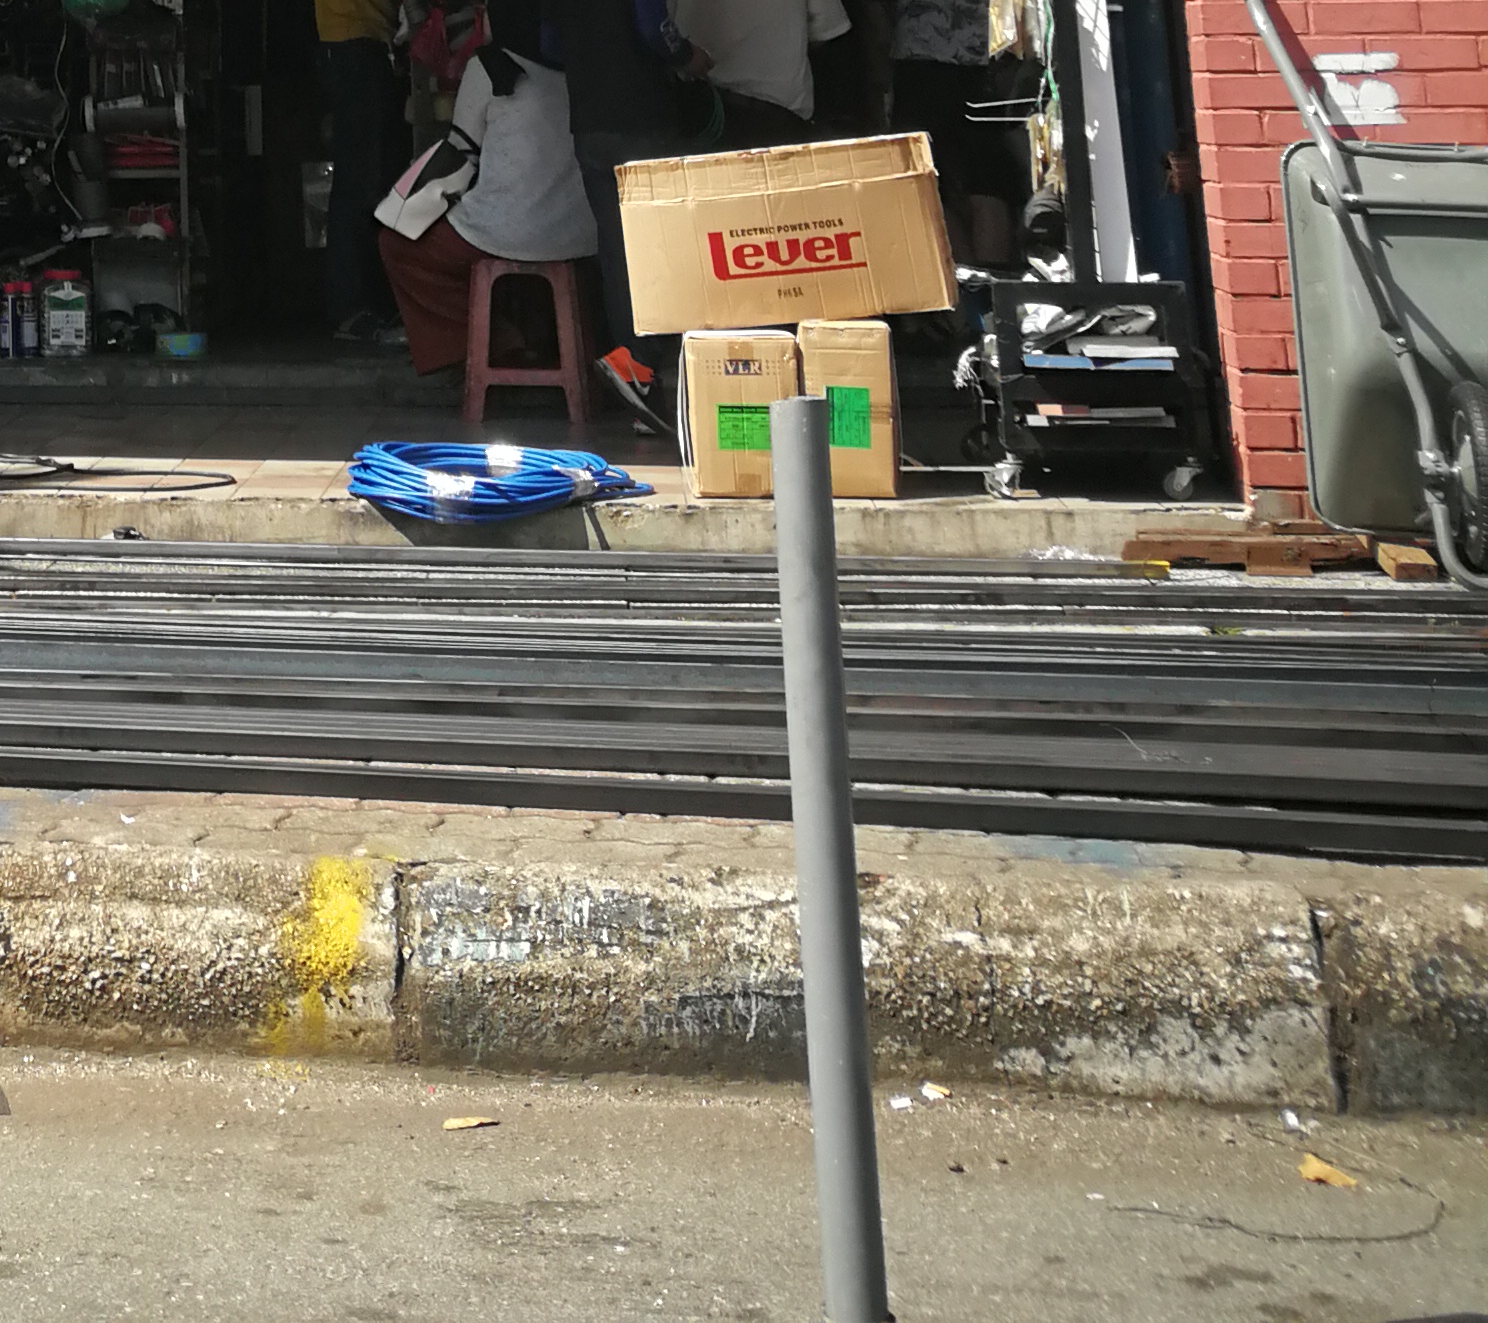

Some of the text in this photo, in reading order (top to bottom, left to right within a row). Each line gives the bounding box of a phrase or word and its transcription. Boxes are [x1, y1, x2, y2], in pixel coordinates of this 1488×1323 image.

[729, 217, 844, 239] ELECTRIC POWER TOOLS
[725, 360, 761, 374] VLR
